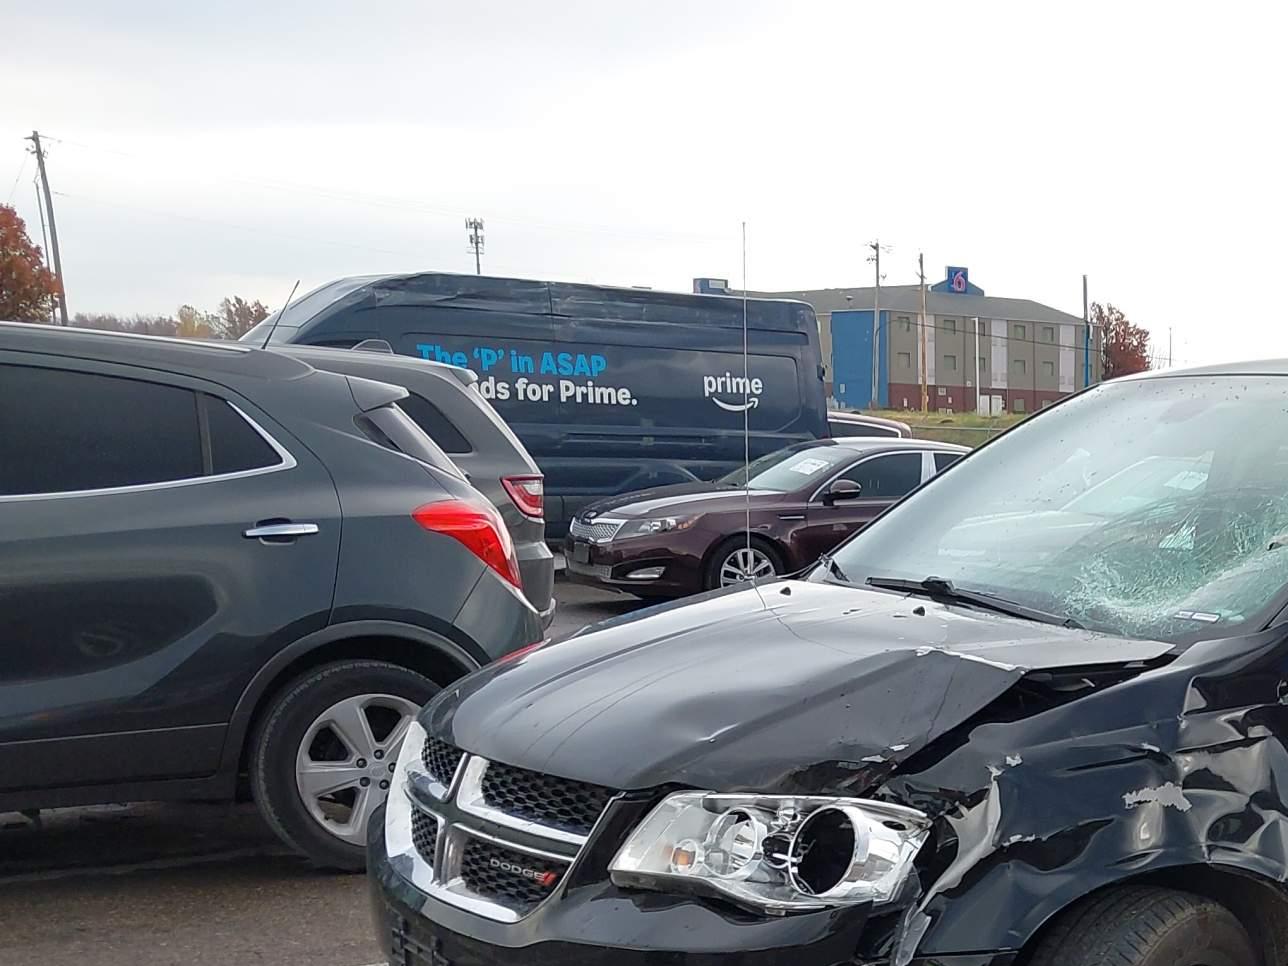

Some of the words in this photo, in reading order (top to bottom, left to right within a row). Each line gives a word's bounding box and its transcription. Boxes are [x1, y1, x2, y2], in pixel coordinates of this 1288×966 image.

[953, 271, 966, 292] 6
[416, 343, 468, 369] The
[511, 350, 534, 374] in
[541, 352, 607, 377] ASAP
[515, 377, 554, 401] for
[560, 379, 638, 406] Prime.
[703, 372, 763, 397] prime
[489, 858, 545, 881] DODGE
